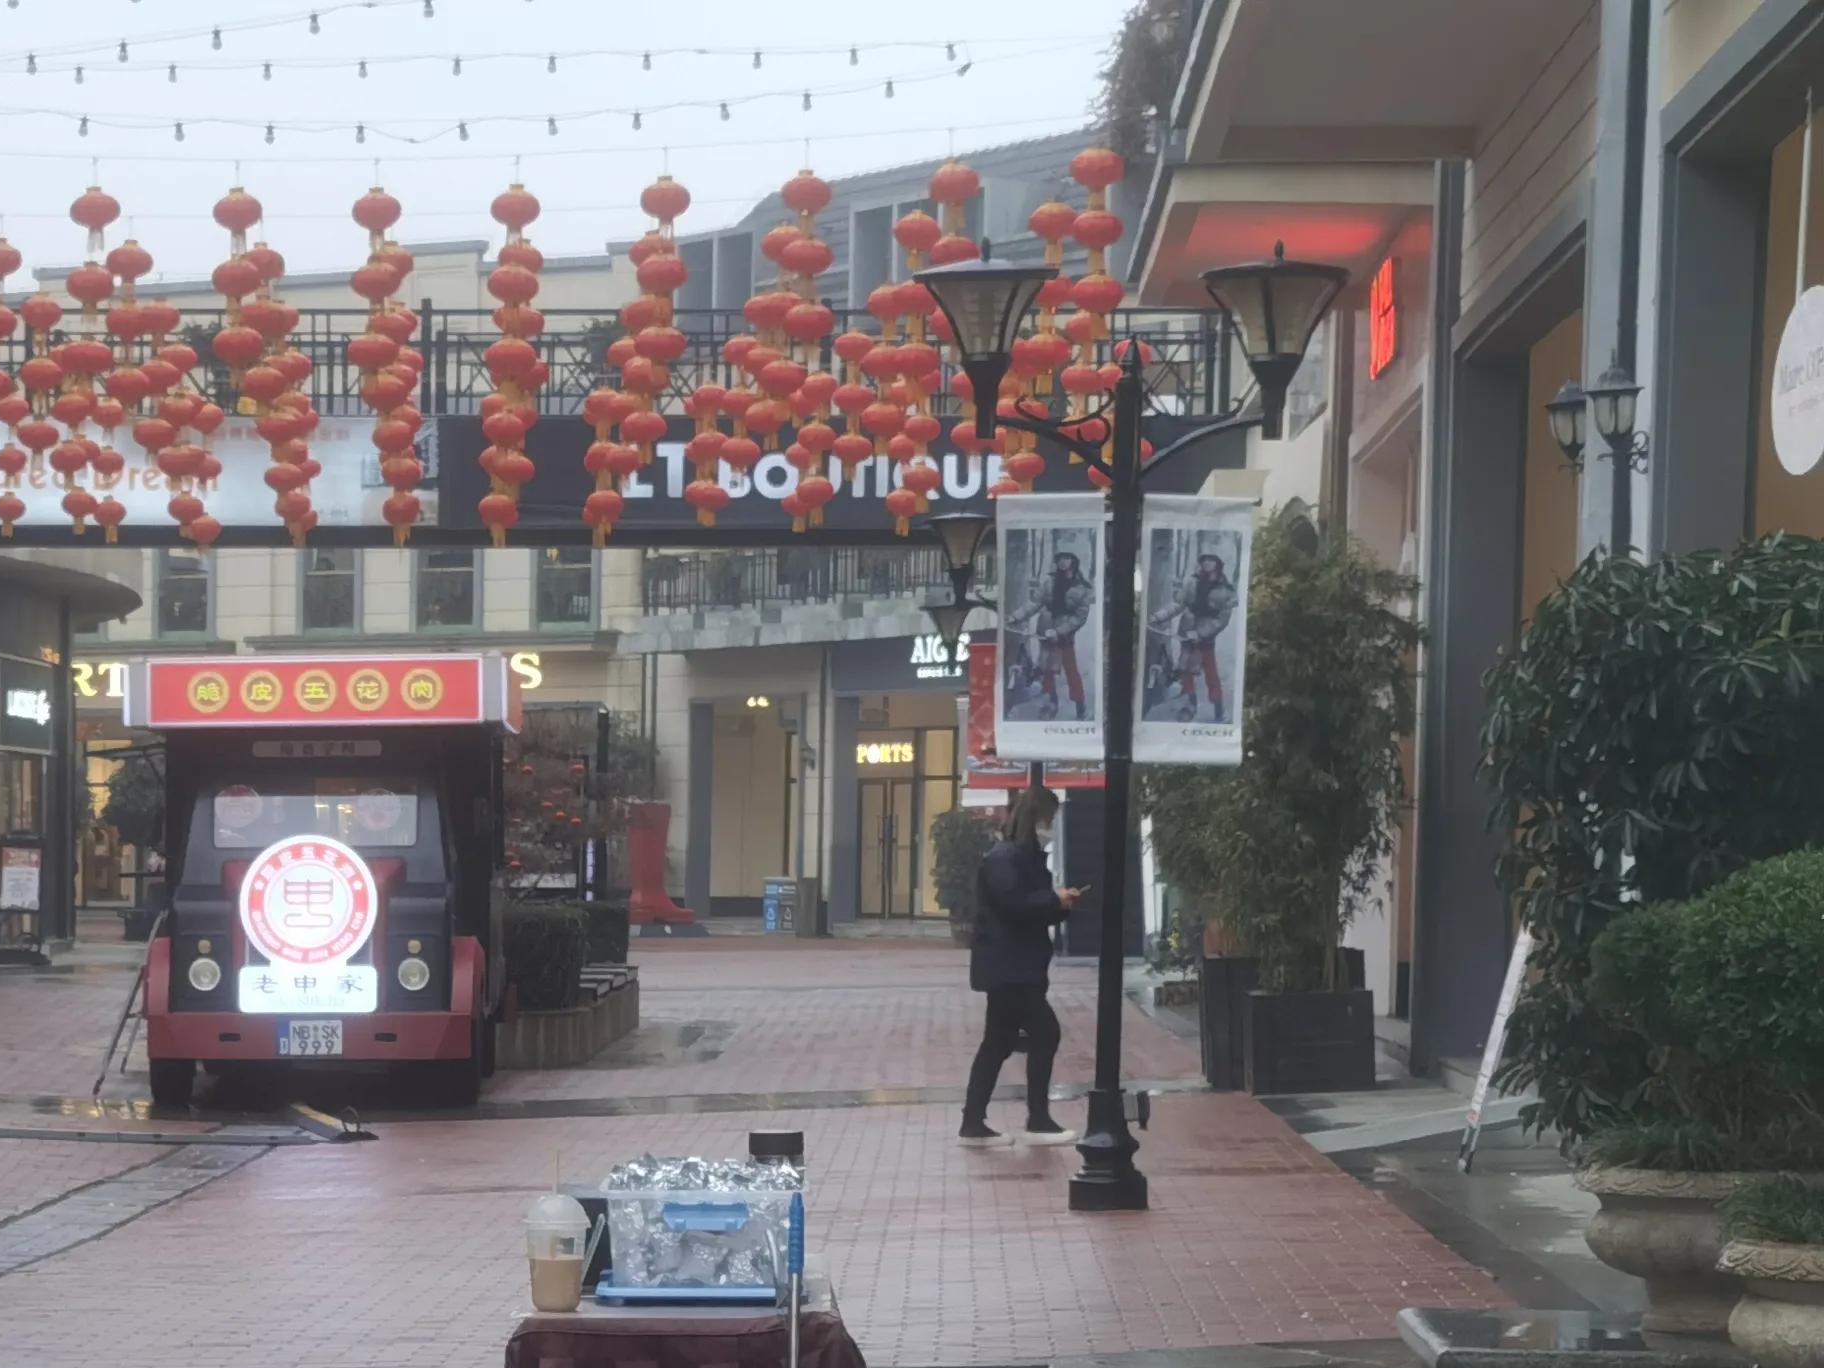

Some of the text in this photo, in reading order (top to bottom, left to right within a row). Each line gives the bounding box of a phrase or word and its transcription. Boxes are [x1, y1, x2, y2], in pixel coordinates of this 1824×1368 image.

[195, 678, 434, 702] 脆皮五花肉
[856, 742, 914, 764] PORTS
[253, 974, 364, 994] 老申家
[298, 1040, 335, 1055] 999
